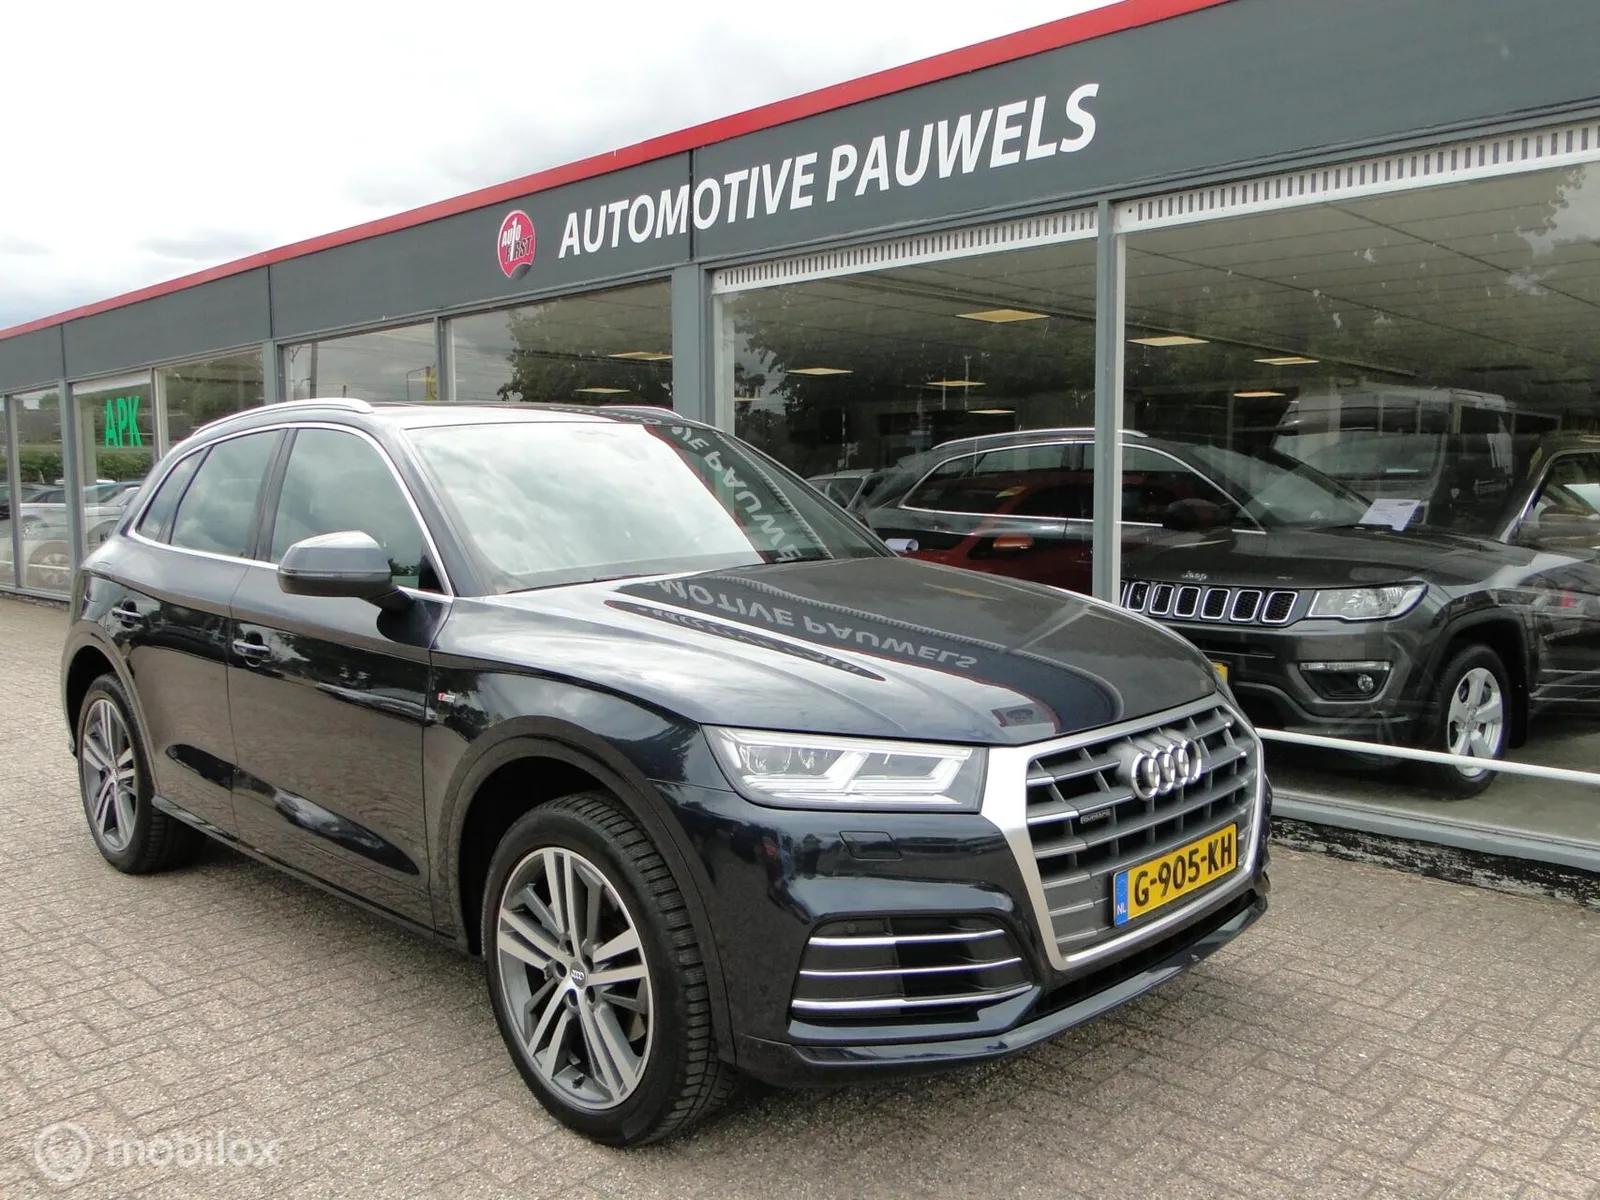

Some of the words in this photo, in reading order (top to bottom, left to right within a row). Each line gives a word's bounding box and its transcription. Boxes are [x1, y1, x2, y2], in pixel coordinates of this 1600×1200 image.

[559, 152, 818, 258] AUTOMOTIVE
[827, 83, 1099, 202] PAUWELS
[105, 396, 142, 449] APK
[1134, 832, 1232, 907] G-905-KH
[1116, 902, 1127, 916] NL
